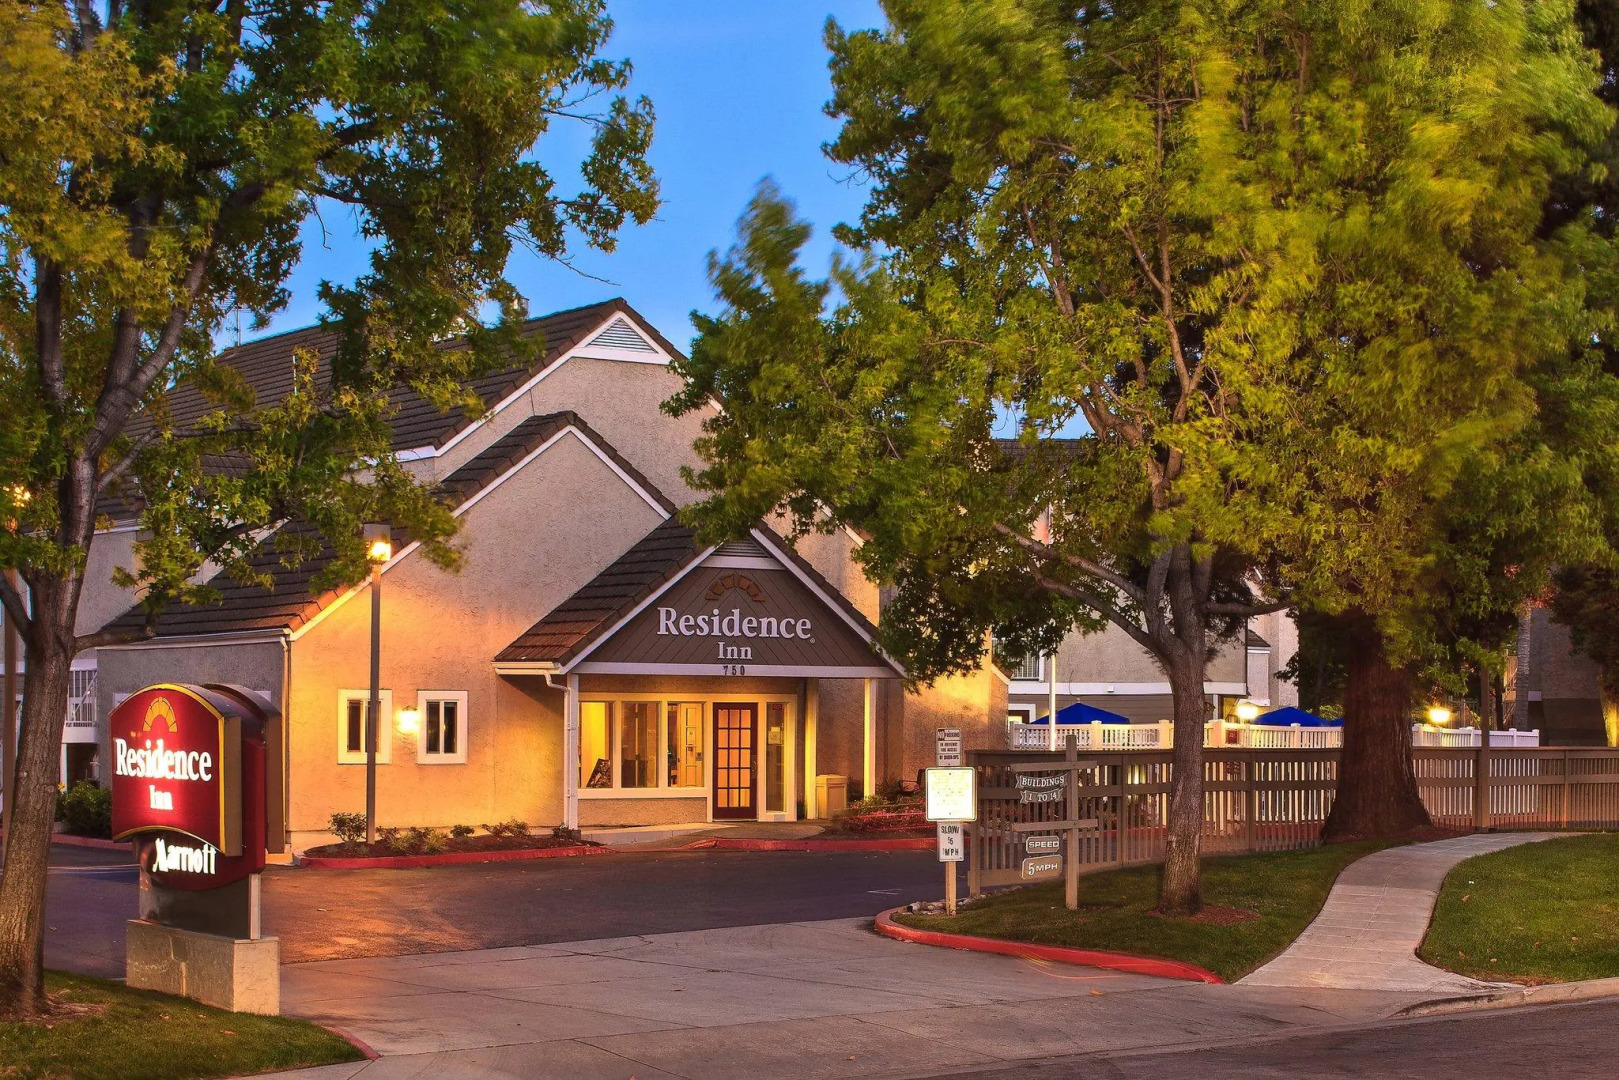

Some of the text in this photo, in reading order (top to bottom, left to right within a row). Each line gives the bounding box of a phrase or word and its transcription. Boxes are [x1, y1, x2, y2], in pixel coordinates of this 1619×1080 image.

[718, 641, 752, 660] Inn
[723, 665, 745, 676] 750
[115, 738, 212, 781] Residence
[1022, 776, 1064, 787] BUILDINGS
[149, 785, 173, 810] Inn
[1050, 792, 1057, 800] 14
[941, 826, 959, 834] SLOW
[1028, 862, 1057, 875] 5 MPH
